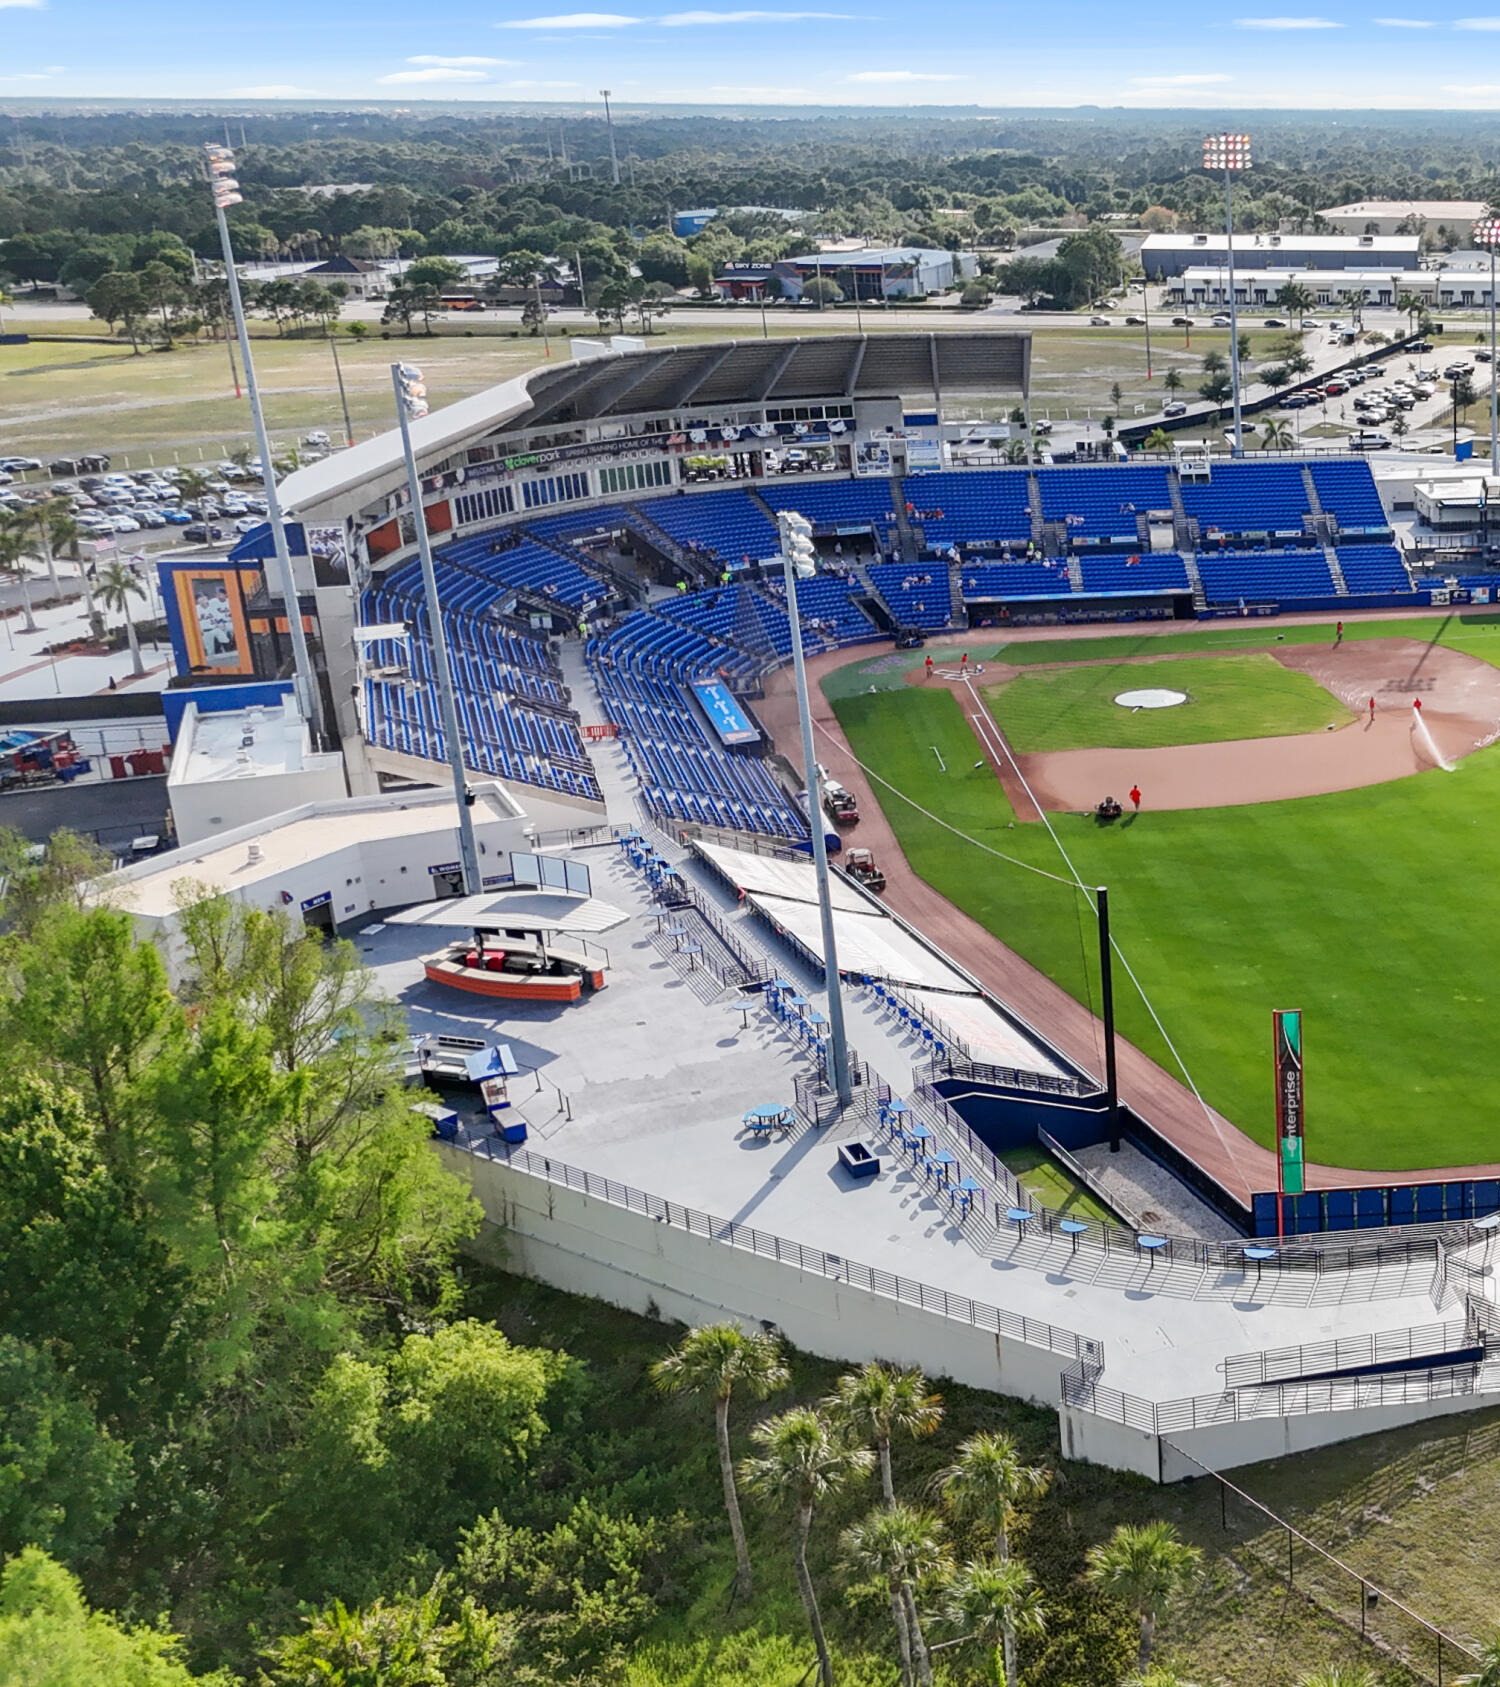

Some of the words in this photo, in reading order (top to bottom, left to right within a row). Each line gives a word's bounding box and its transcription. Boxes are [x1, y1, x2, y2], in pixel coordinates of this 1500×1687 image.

[735, 262, 750, 270] SKY
[751, 262, 772, 270] ZONE
[467, 466, 495, 477] WELCOME
[588, 443, 618, 454] TRAINING
[619, 441, 639, 450] HOME
[640, 439, 650, 447] OF
[1284, 1071, 1297, 1158] enterprise
